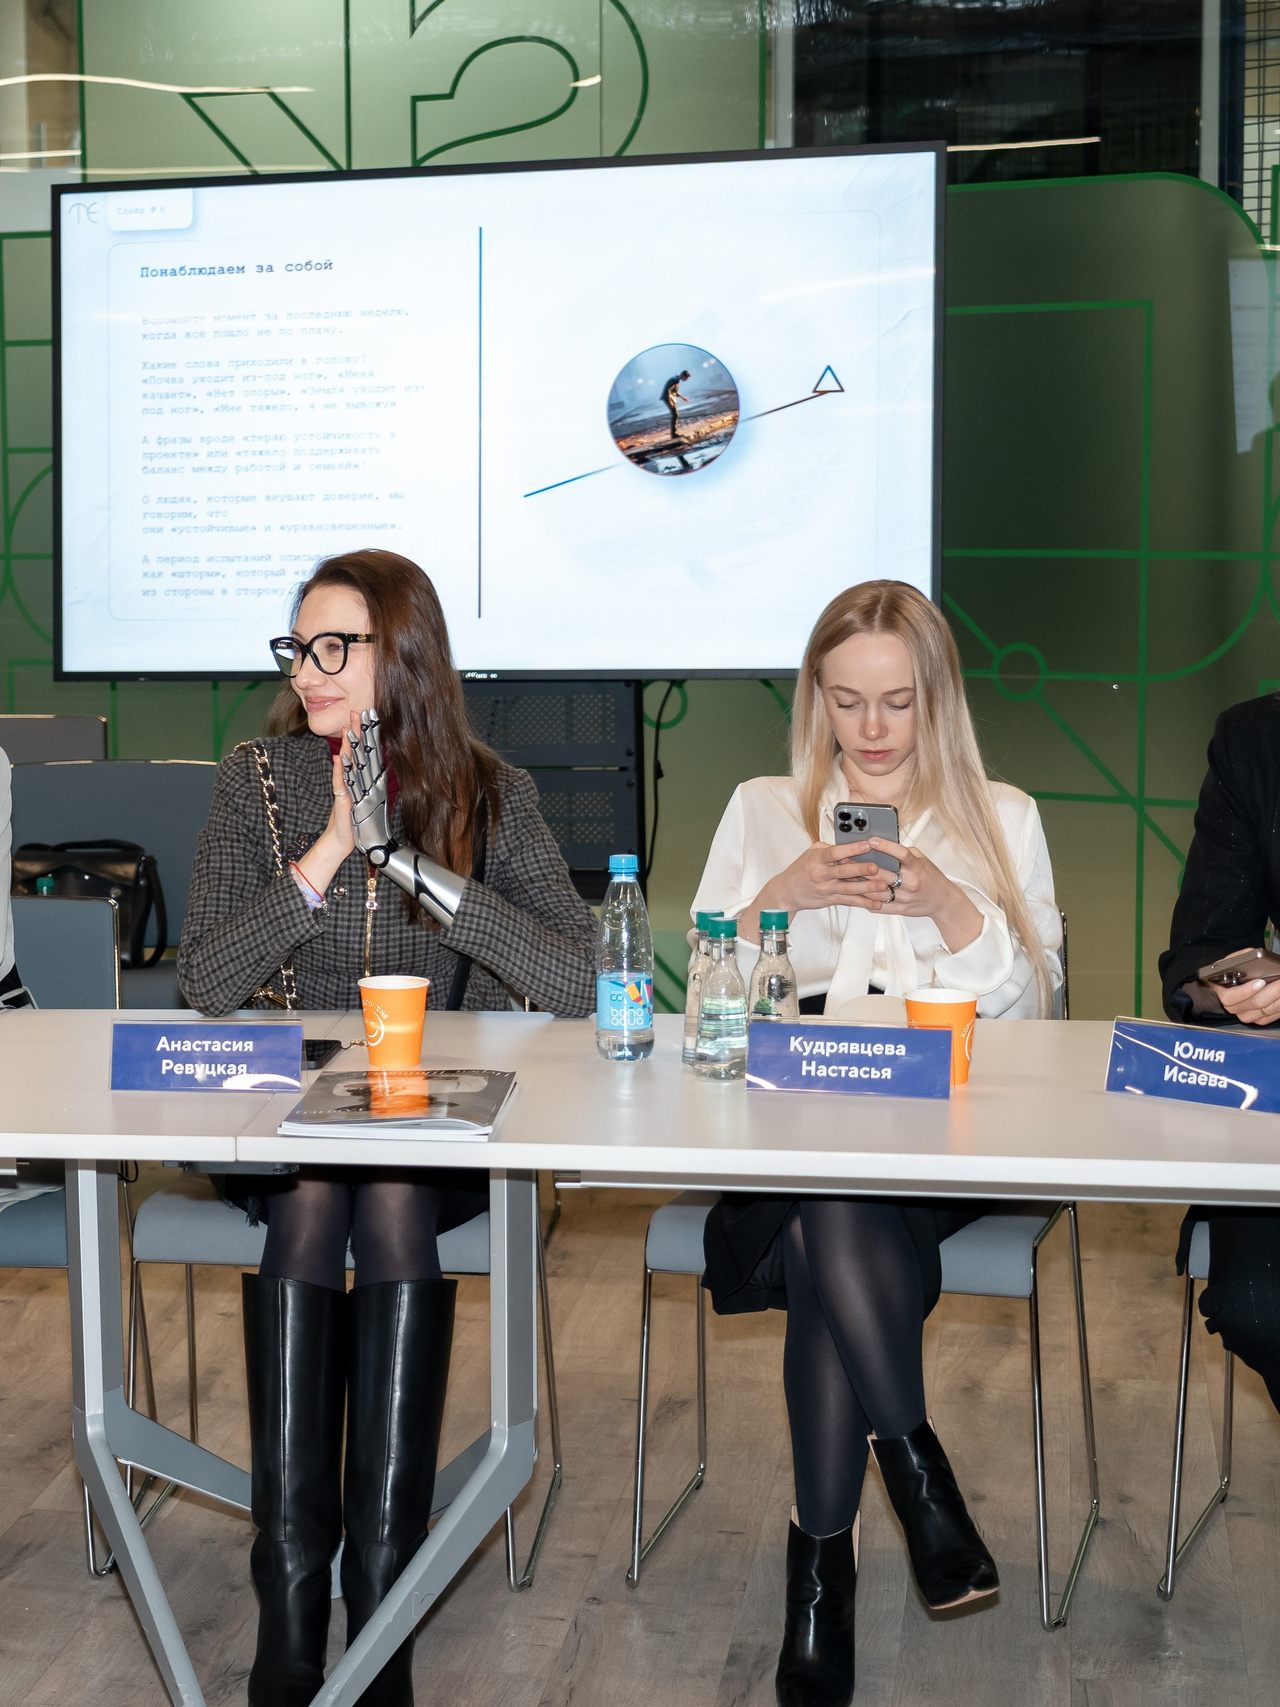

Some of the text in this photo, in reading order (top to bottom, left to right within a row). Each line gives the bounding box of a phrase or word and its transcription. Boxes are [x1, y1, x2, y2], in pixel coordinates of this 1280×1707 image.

[140, 259, 333, 278] Понаблюдаем за собой
[214, 313, 258, 322] момент
[358, 308, 409, 317] неделю,
[141, 332, 178, 341] когда
[213, 330, 250, 338] пошло
[256, 329, 271, 337] не
[141, 360, 178, 369] Какие
[185, 360, 222, 368] слова
[228, 358, 294, 369] приходили
[141, 374, 185, 384] «Почва
[242, 373, 287, 381] из-под
[293, 372, 329, 380] ног»,
[336, 369, 373, 379] «Меня
[141, 391, 199, 400] качает»,
[207, 388, 237, 398] «Нет
[243, 388, 294, 399] опоры»,
[301, 385, 346, 395] «Земля
[141, 407, 164, 416] под
[170, 406, 206, 415] ног»,
[214, 403, 244, 413] «Мне
[250, 404, 301, 412] тяжело,
[156, 434, 193, 446] фразы
[199, 435, 236, 445] вроде
[243, 434, 287, 444] «теряю
[141, 451, 200, 462] проекте»
[206, 450, 229, 458] или
[235, 449, 286, 457] «тяжело
[141, 465, 185, 474] баланс
[192, 465, 229, 475] между
[235, 461, 287, 475] работой
[156, 496, 199, 505] людях,
[207, 495, 258, 505] которые
[323, 493, 381, 503] доверие,
[141, 511, 198, 521] говорим,
[170, 523, 258, 535] «устойчивые»
[156, 556, 200, 566] период
[206, 553, 272, 563] испытаний
[170, 570, 228, 580] «шторм»,
[235, 567, 287, 579] который
[163, 588, 214, 598] стороны
[156, 1036, 253, 1052] Анастасия
[790, 1036, 906, 1057] Кудрявцева
[1174, 1041, 1226, 1063] Юлия
[161, 1059, 247, 1078] Ревуцкая
[801, 1060, 892, 1079] Настасья
[1164, 1065, 1228, 1089] Исаева
